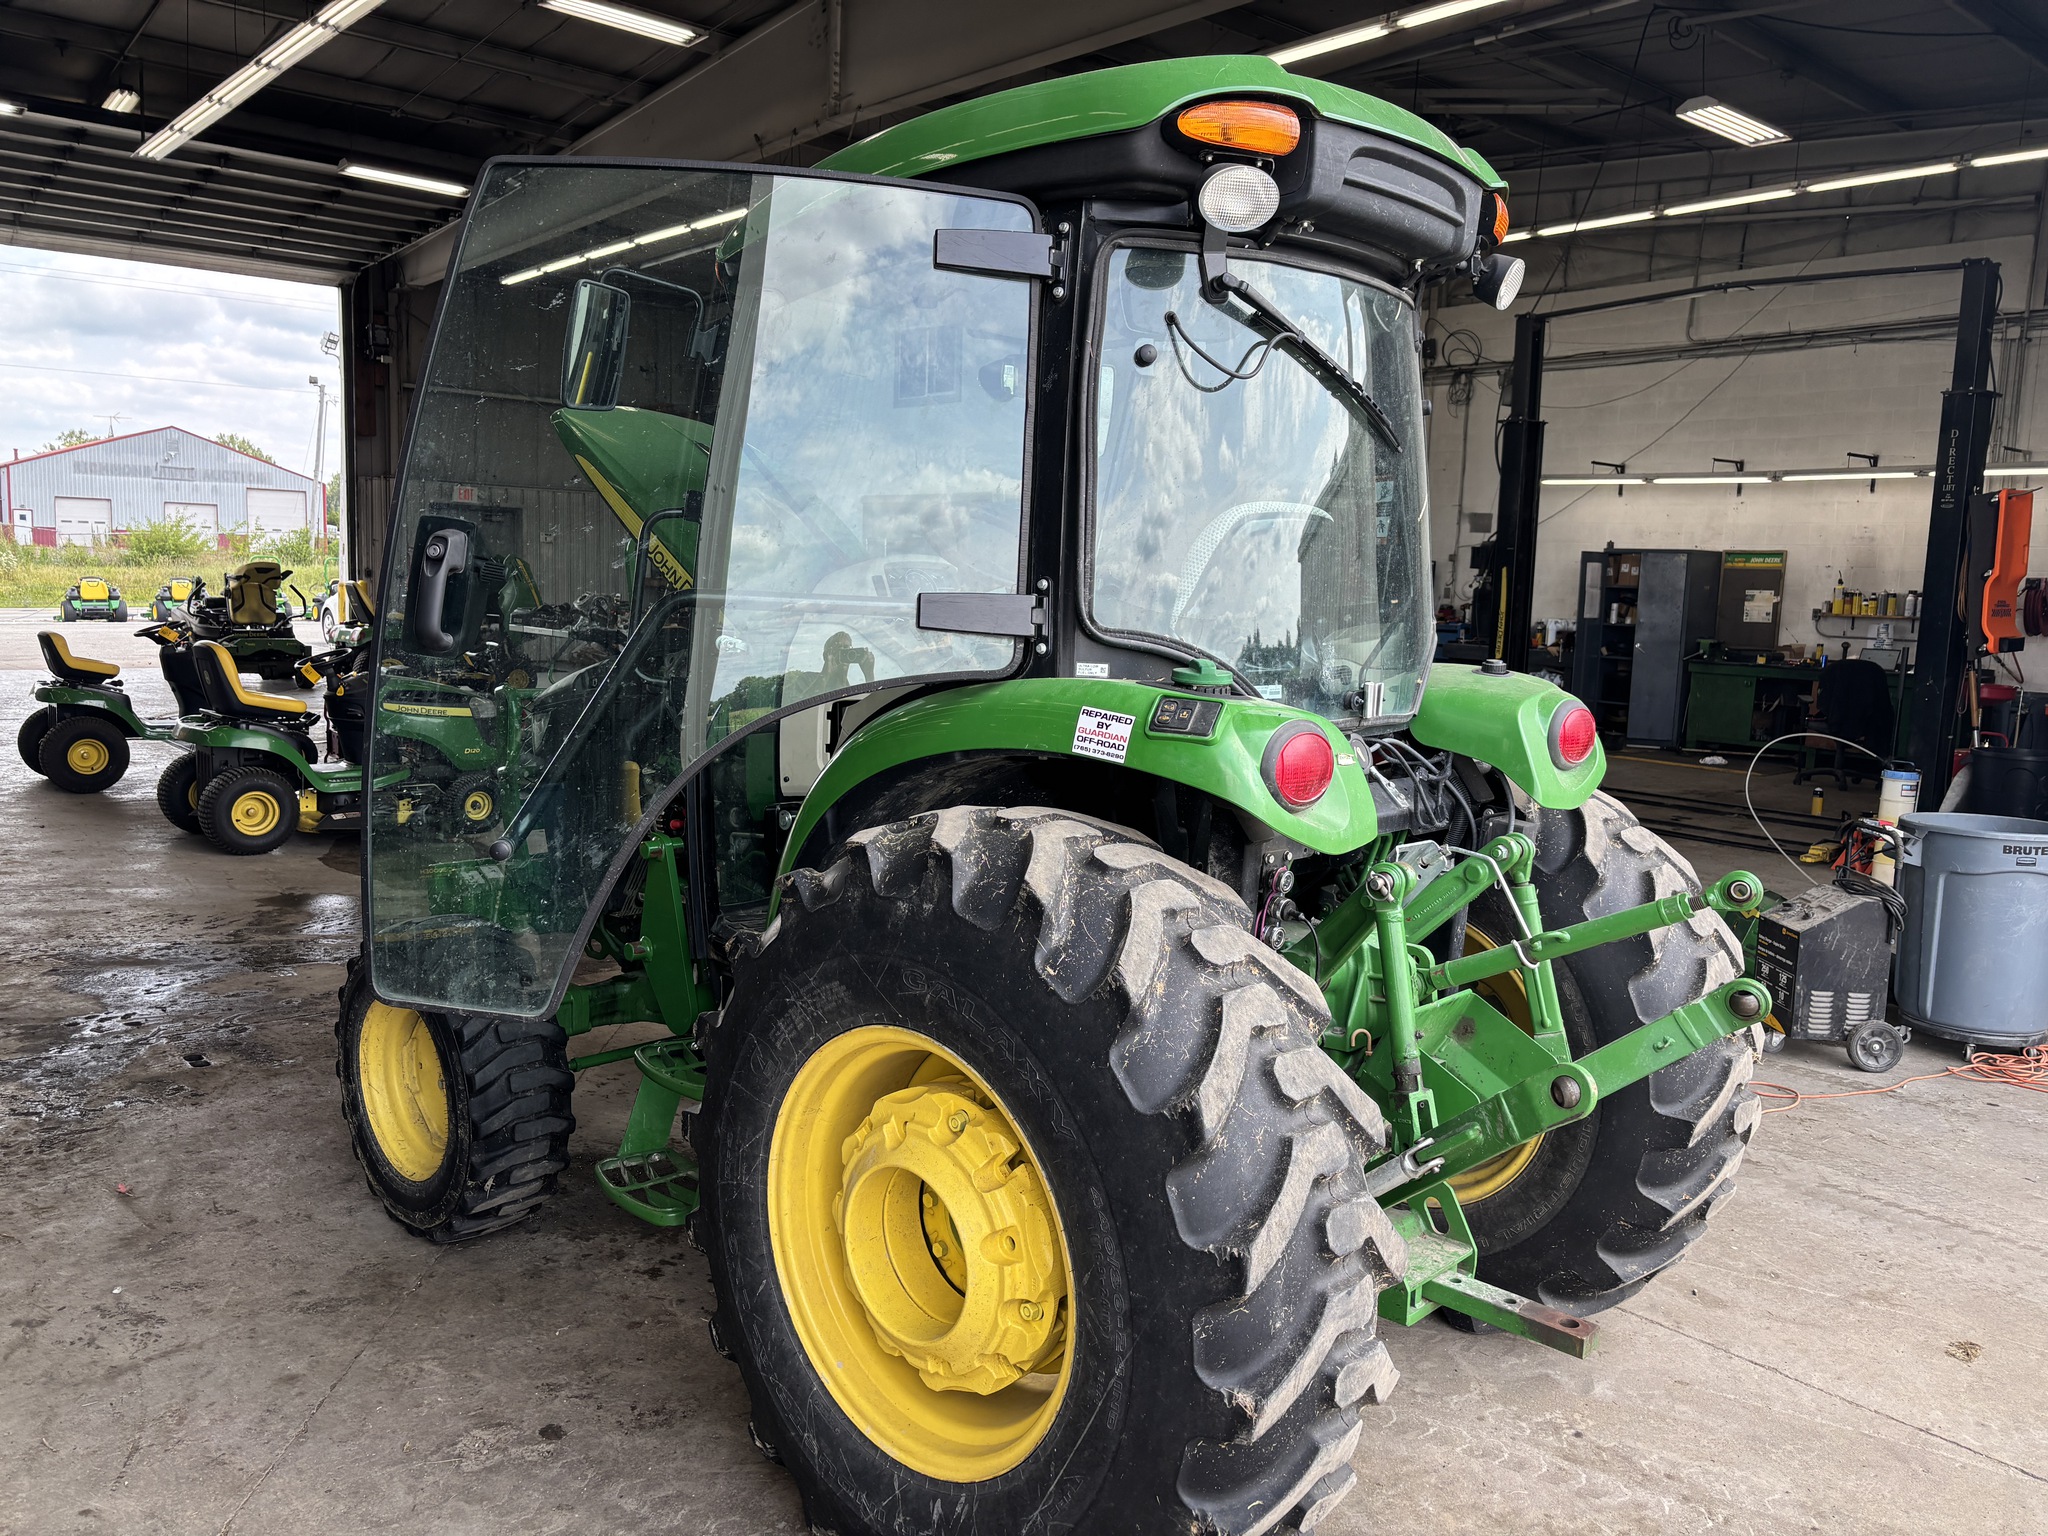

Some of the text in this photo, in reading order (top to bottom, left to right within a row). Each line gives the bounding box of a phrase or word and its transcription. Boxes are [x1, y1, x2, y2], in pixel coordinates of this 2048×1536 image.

[1947, 429, 1959, 484] DIRECT
[648, 545, 682, 586] JOHN
[395, 704, 448, 716] JOHN DEERE
[1081, 708, 1133, 725] REPAIRED
[1096, 721, 1112, 730] BY
[1076, 735, 1125, 751] OFF-ROAD
[1077, 726, 1127, 743] GUARDIAN
[2002, 845, 2048, 856] BRUTE
[902, 969, 1076, 1140] GALAXY
[1493, 1112, 1594, 1241] NDUSTRIAL
